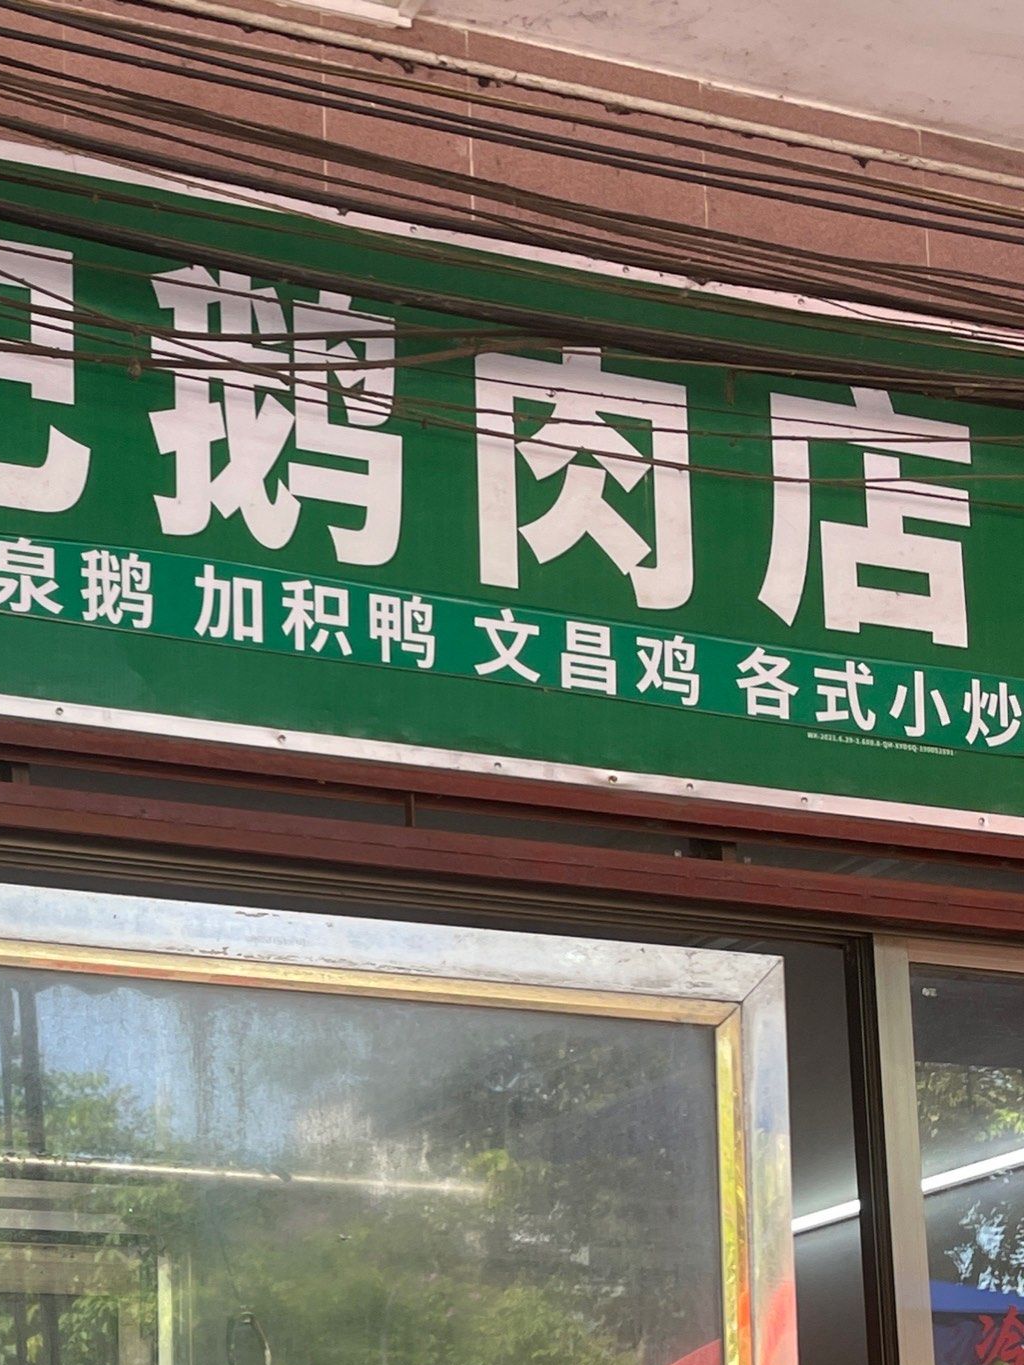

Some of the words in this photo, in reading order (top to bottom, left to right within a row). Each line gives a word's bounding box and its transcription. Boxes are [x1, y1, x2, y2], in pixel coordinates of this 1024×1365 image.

[195, 564, 436, 669] 加积鸭
[474, 608, 700, 706] 文昌鸡
[736, 646, 1022, 747] 各式小炒
